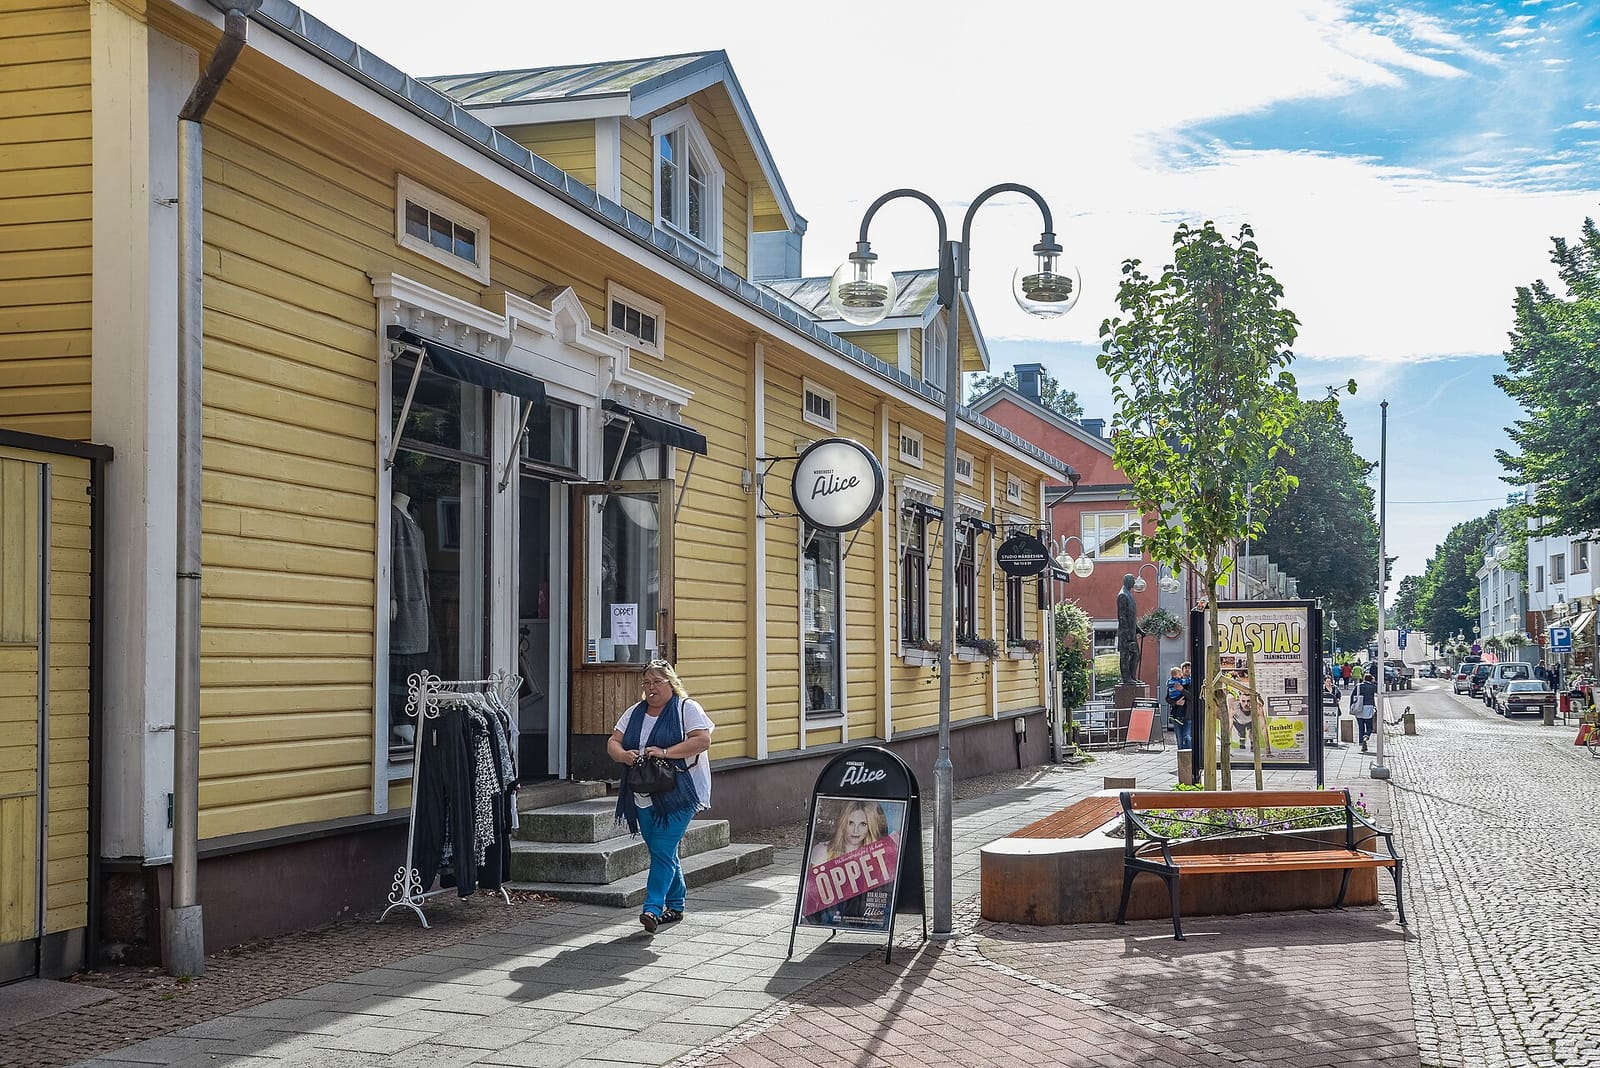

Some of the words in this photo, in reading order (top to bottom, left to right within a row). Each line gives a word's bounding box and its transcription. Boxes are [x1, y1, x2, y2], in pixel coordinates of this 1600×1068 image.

[811, 474, 860, 500] Alice
[1217, 616, 1301, 653] BÄSTA!
[1553, 628, 1568, 646] P
[839, 766, 887, 787] Alice
[812, 848, 890, 905] ÖPPET
